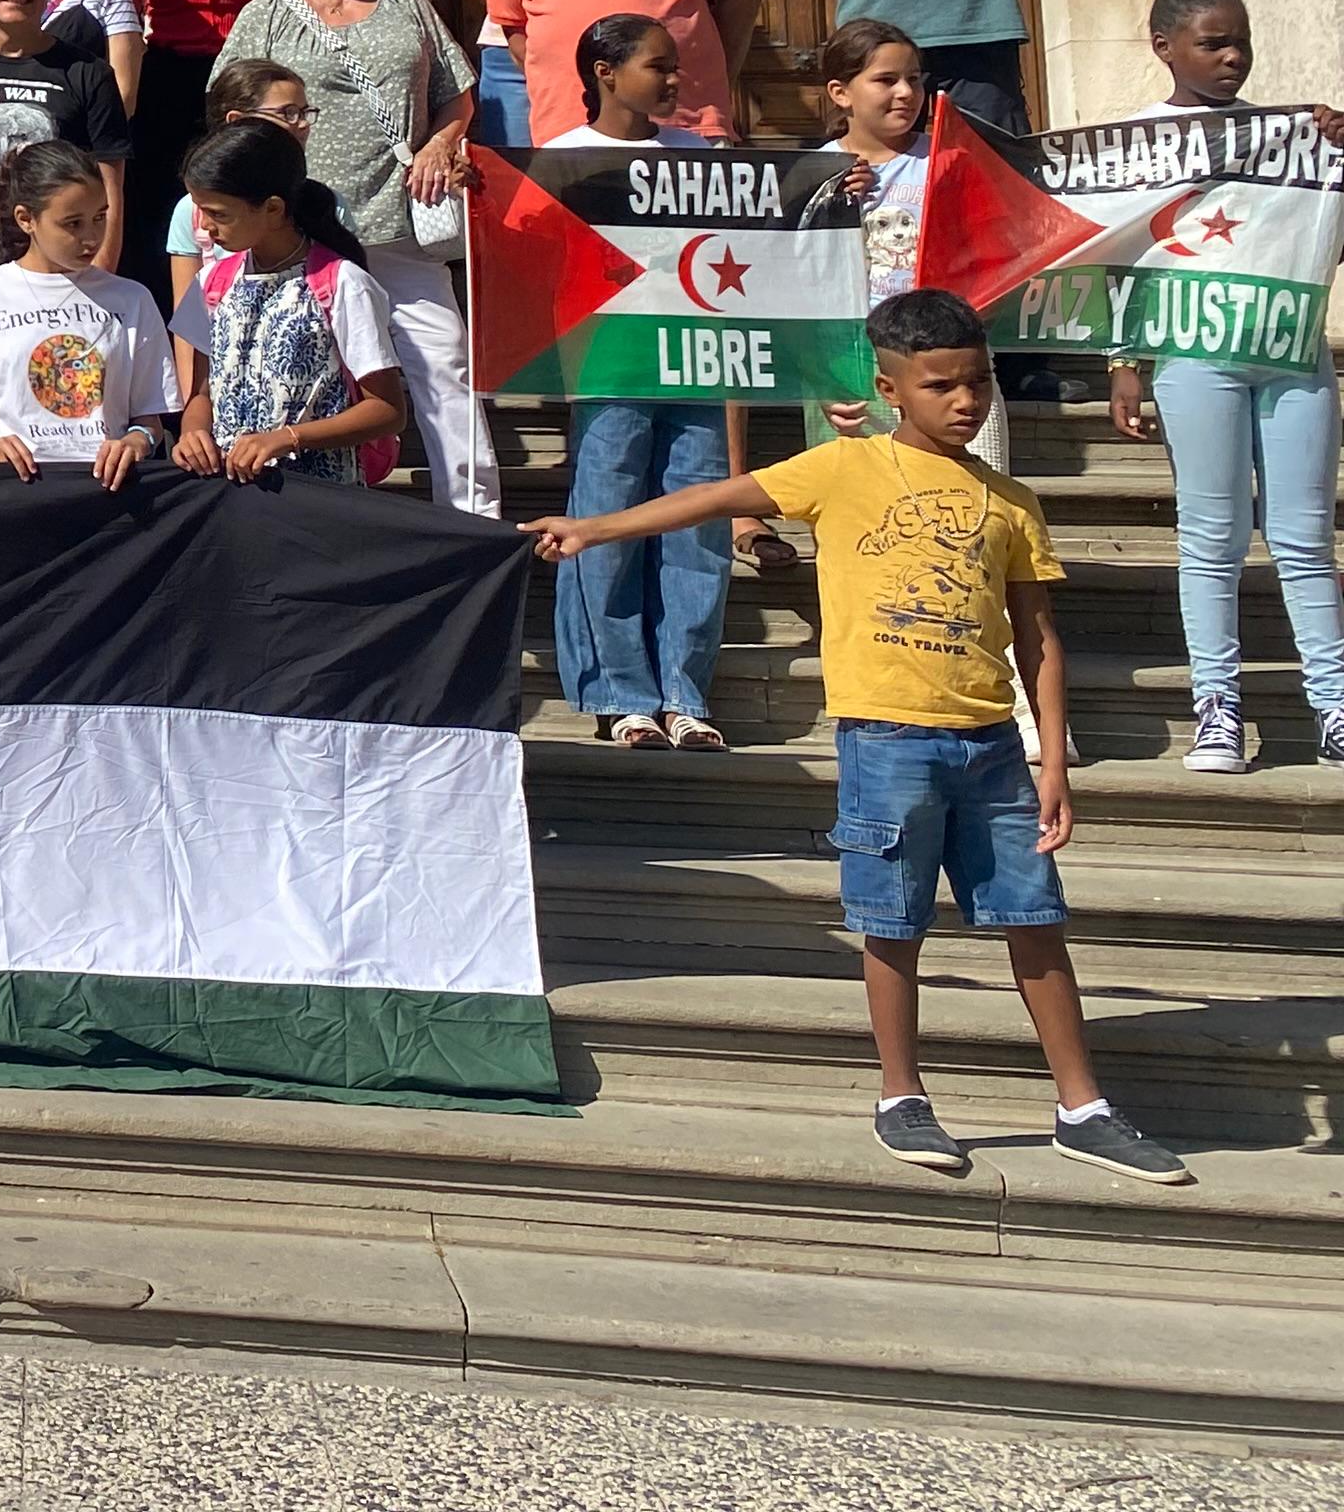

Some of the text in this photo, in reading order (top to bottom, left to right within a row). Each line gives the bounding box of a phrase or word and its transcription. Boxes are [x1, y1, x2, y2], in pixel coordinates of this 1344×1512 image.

[4, 87, 47, 102] WAR
[1041, 120, 1211, 189] SAHARA
[628, 159, 784, 218] SAHARA
[1018, 274, 1094, 341] PAZ
[1104, 275, 1135, 344] Y
[657, 327, 775, 388] LIBRE
[28, 421, 75, 438] Ready
[79, 422, 95, 436] to
[873, 632, 969, 656] COOL TRAVEL
